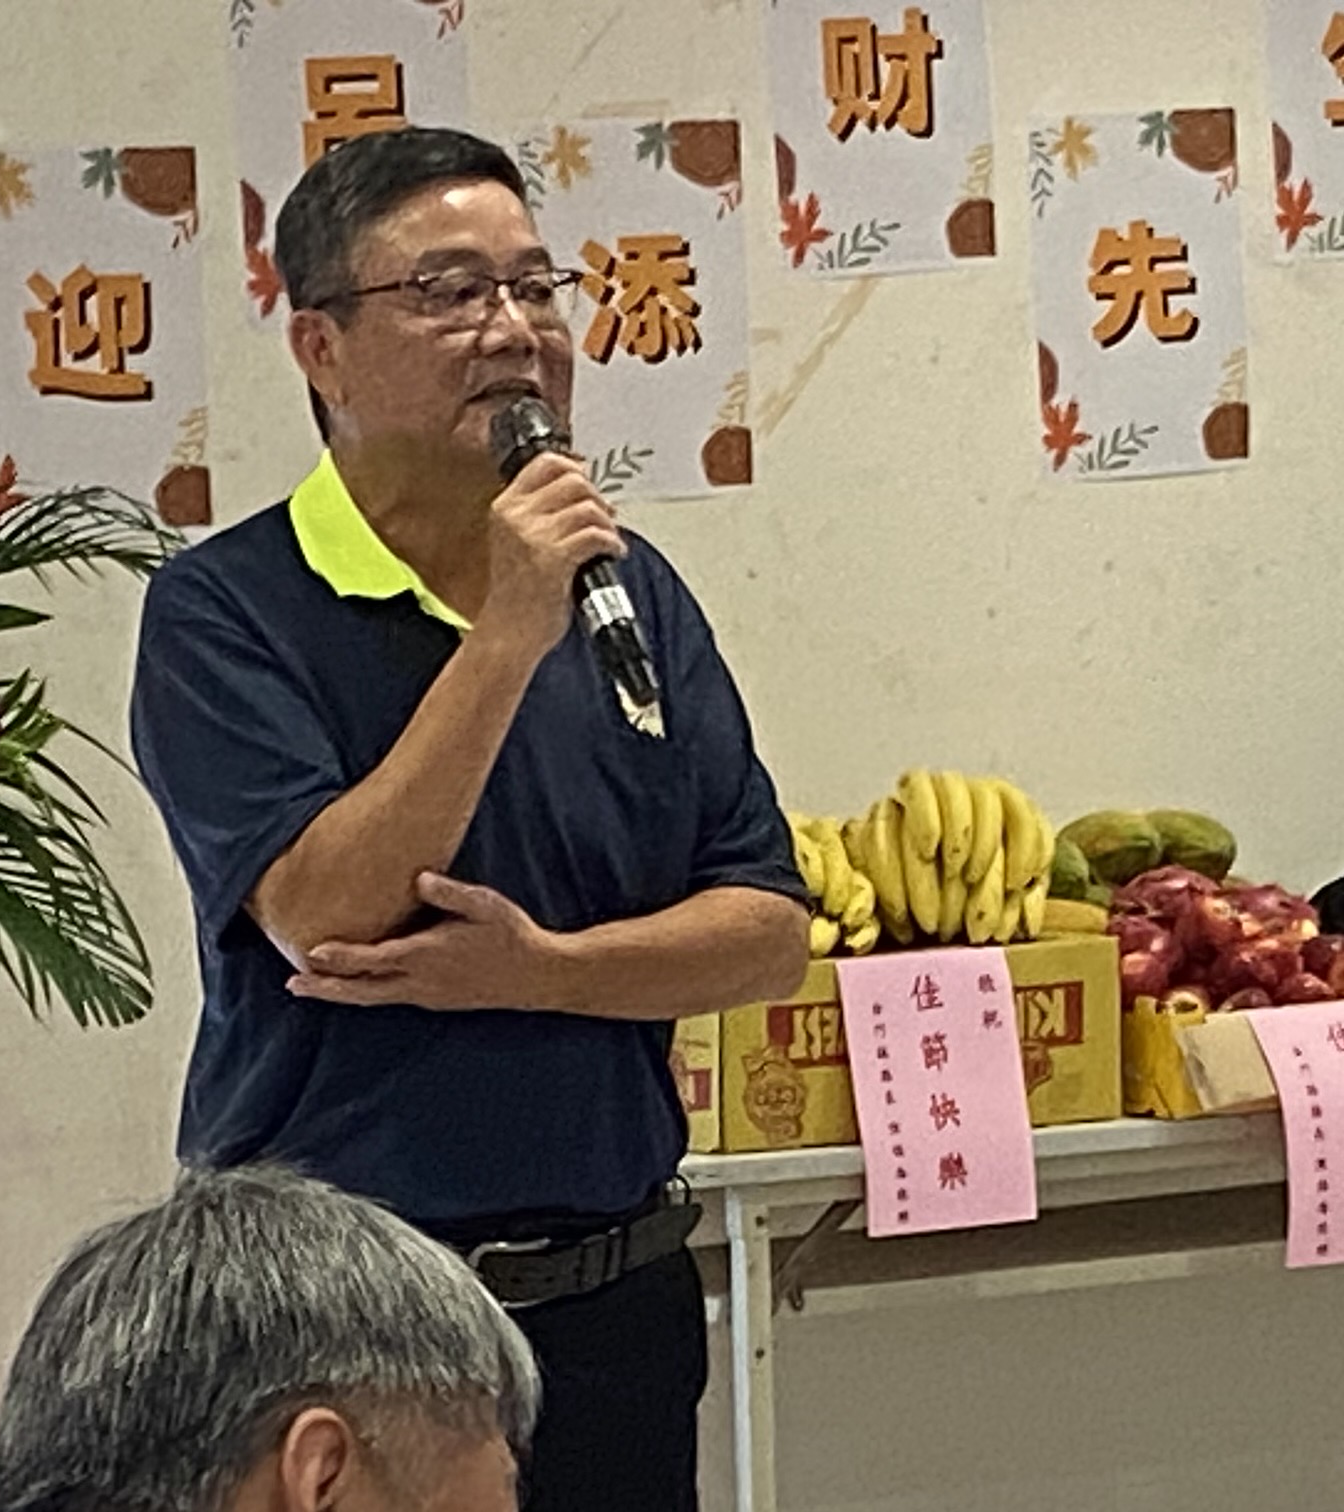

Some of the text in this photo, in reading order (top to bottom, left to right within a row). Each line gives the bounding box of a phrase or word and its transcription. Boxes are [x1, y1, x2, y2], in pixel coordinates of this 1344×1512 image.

[24, 263, 153, 401] 迎
[580, 233, 703, 365] 添
[820, 6, 943, 143] 财
[1087, 219, 1199, 348] 先
[909, 974, 968, 1191] 佳節快樂
